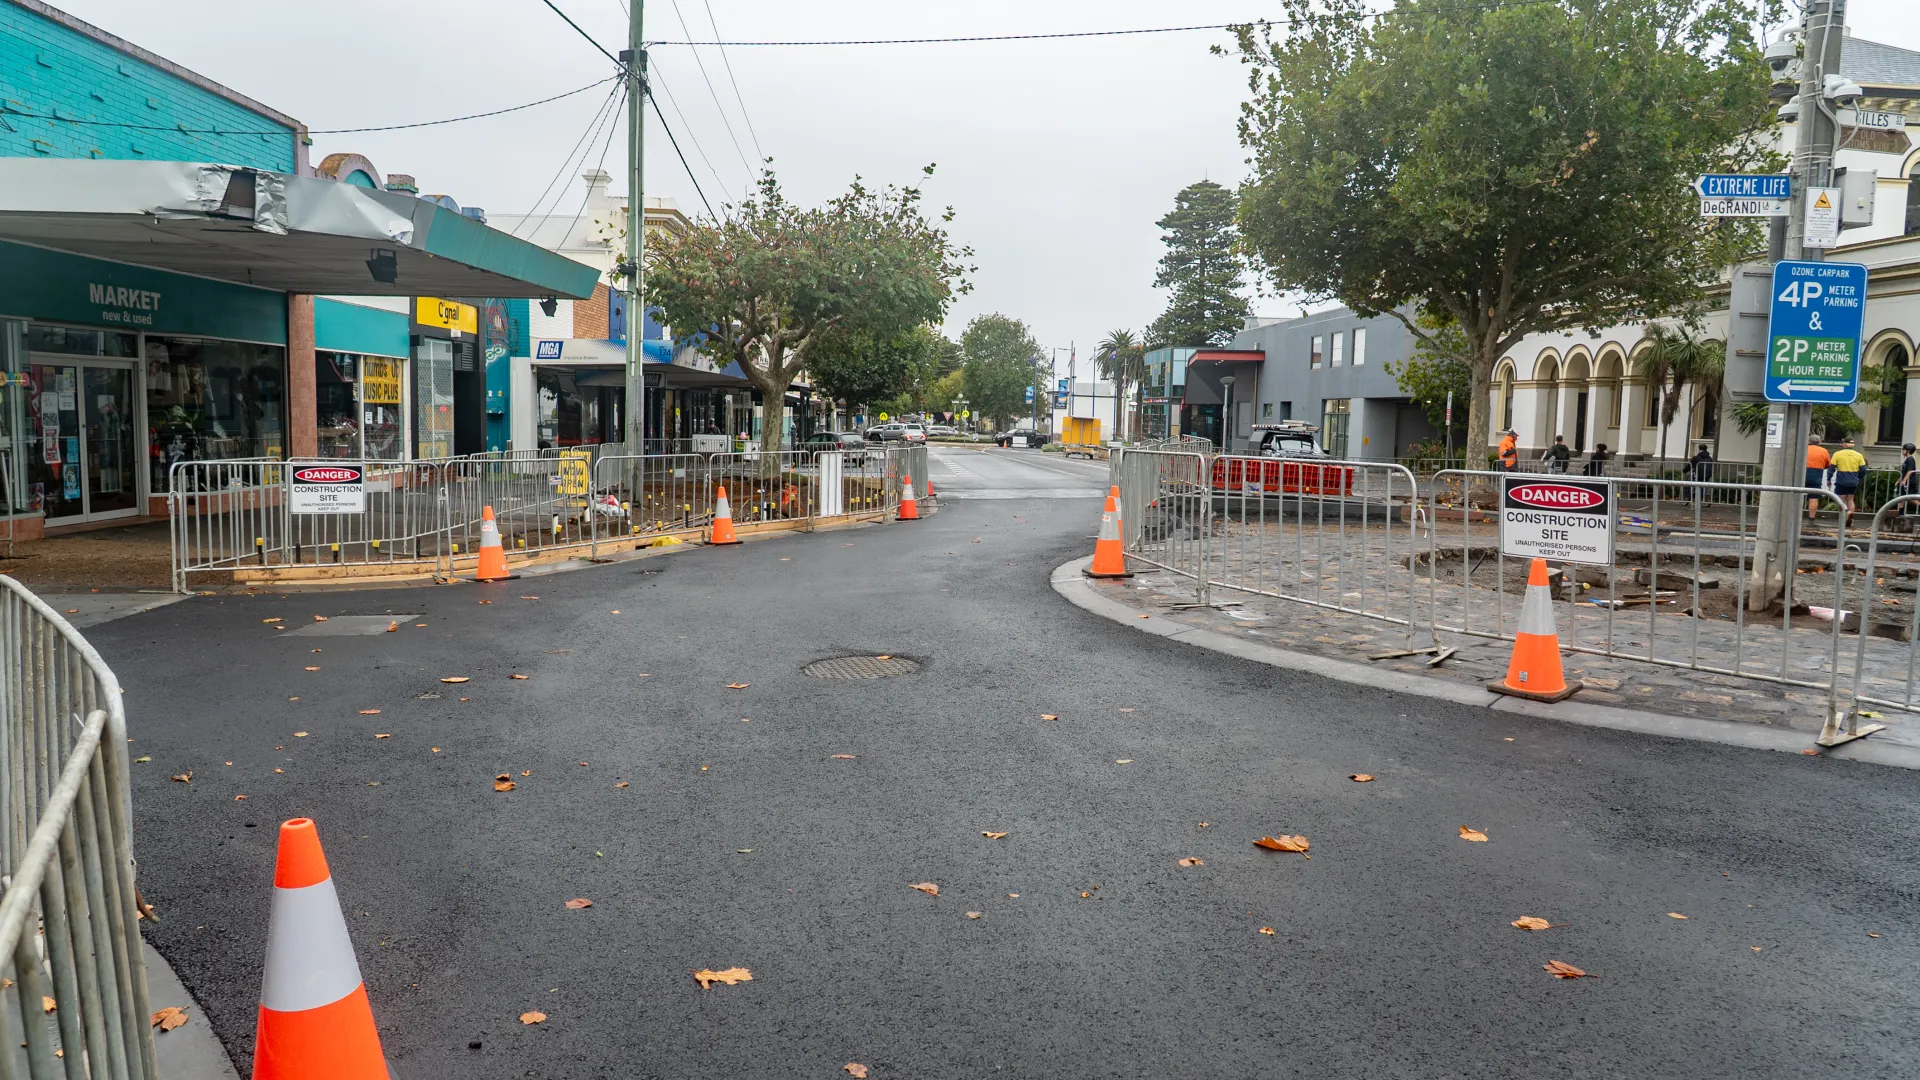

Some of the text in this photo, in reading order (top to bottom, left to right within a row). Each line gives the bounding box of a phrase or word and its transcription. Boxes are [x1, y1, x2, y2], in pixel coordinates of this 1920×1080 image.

[1861, 130, 1875, 140] OLD
[1709, 178, 1786, 195] EXTREME LIFE
[1703, 201, 1769, 214] DeGRANDI LA
[1791, 267, 1850, 278] OZONE CARPARK
[89, 283, 161, 311] MARKET
[1778, 281, 1823, 308] 4P
[1828, 285, 1855, 296] METER
[1823, 296, 1858, 308] PARKING
[102, 310, 152, 324] new & used
[1809, 311, 1823, 330] &
[540, 342, 559, 355] MGA
[659, 348, 671, 356] 174
[1775, 338, 1809, 362] 2P
[1816, 341, 1846, 351] METER
[1810, 352, 1850, 362] PARKING
[1780, 365, 1843, 377] 1 HOUR FREE
[363, 383, 399, 400] MUSIC PLUS
[304, 471, 351, 479] DANGER
[319, 494, 338, 502] SITE
[1521, 488, 1590, 505] DANGER
[1506, 511, 1607, 529] CONSTRUCTION
[1541, 529, 1569, 541] SITE
[1515, 540, 1597, 553] UNAUTHORISED PERSONS
